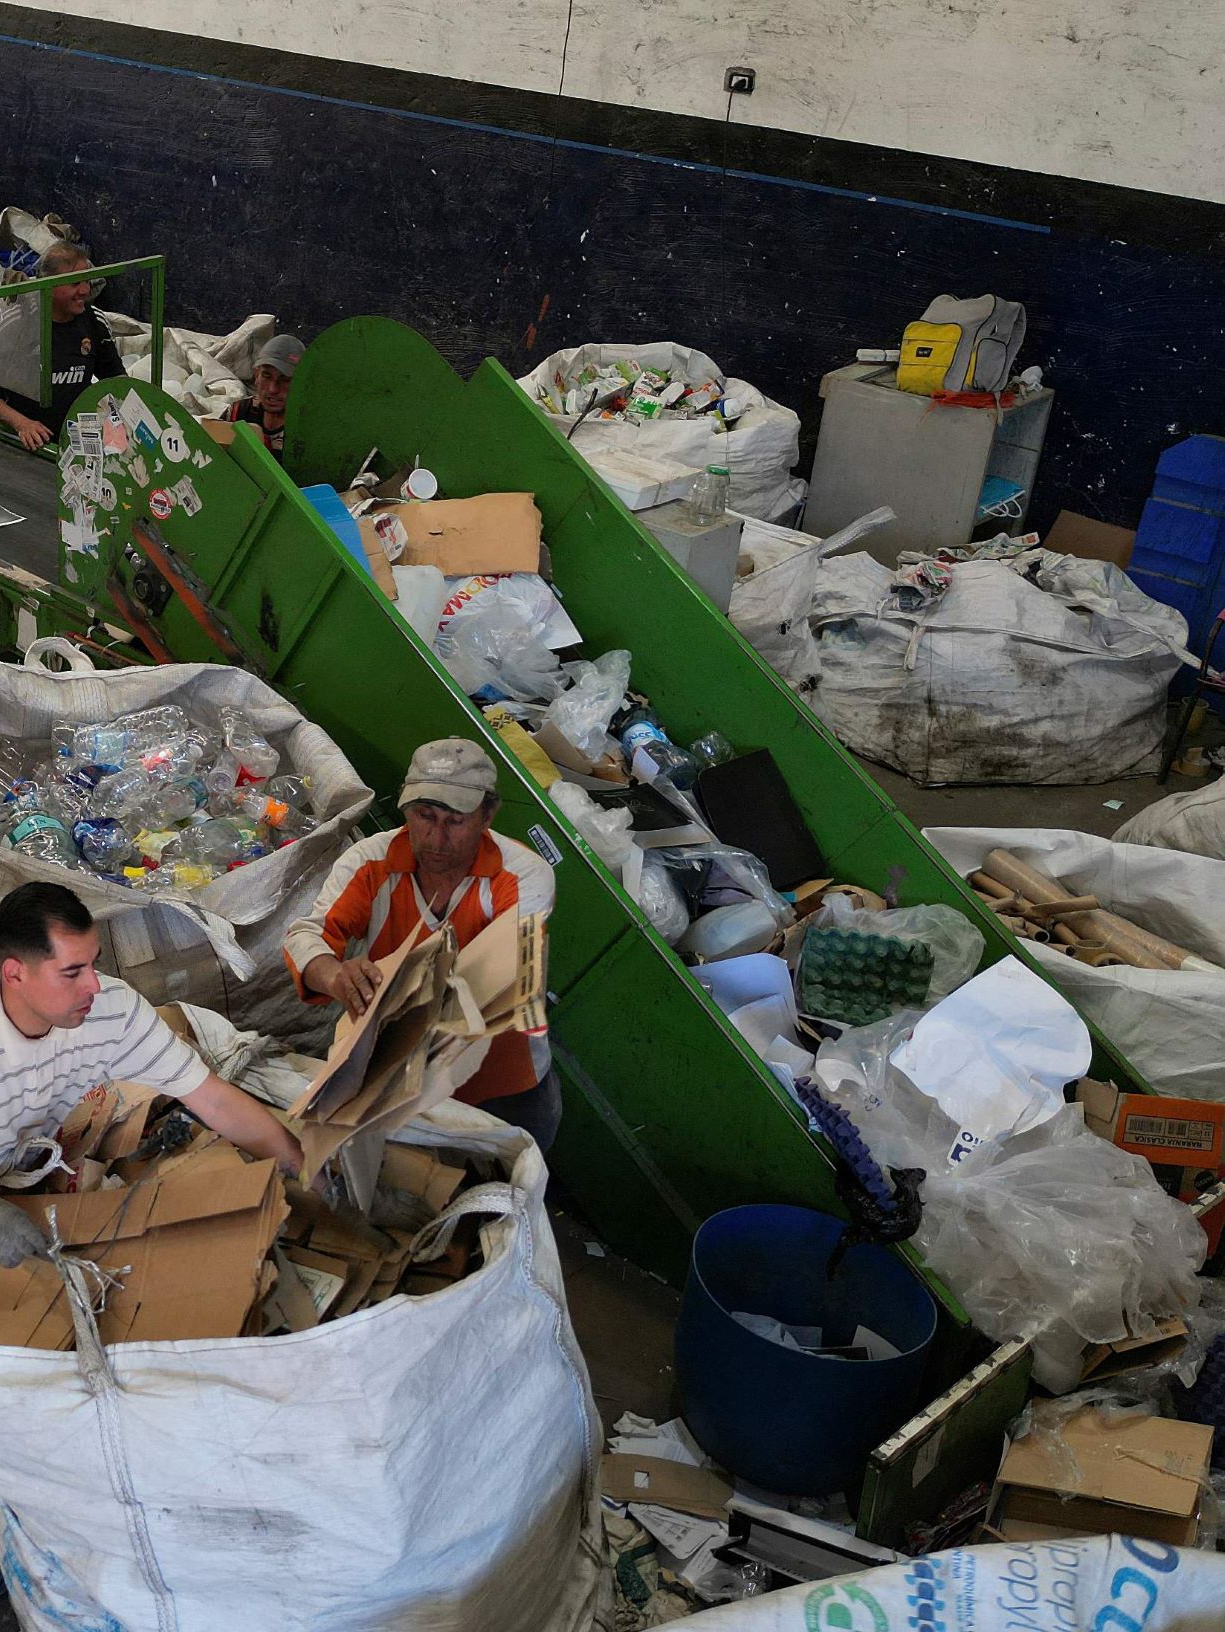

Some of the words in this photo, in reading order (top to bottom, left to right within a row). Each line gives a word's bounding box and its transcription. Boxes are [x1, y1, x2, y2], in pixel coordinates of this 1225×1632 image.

[166, 437, 179, 453] 11
[1135, 1135, 1166, 1144] CLASICA
[1167, 1138, 1202, 1149] NARANJA
